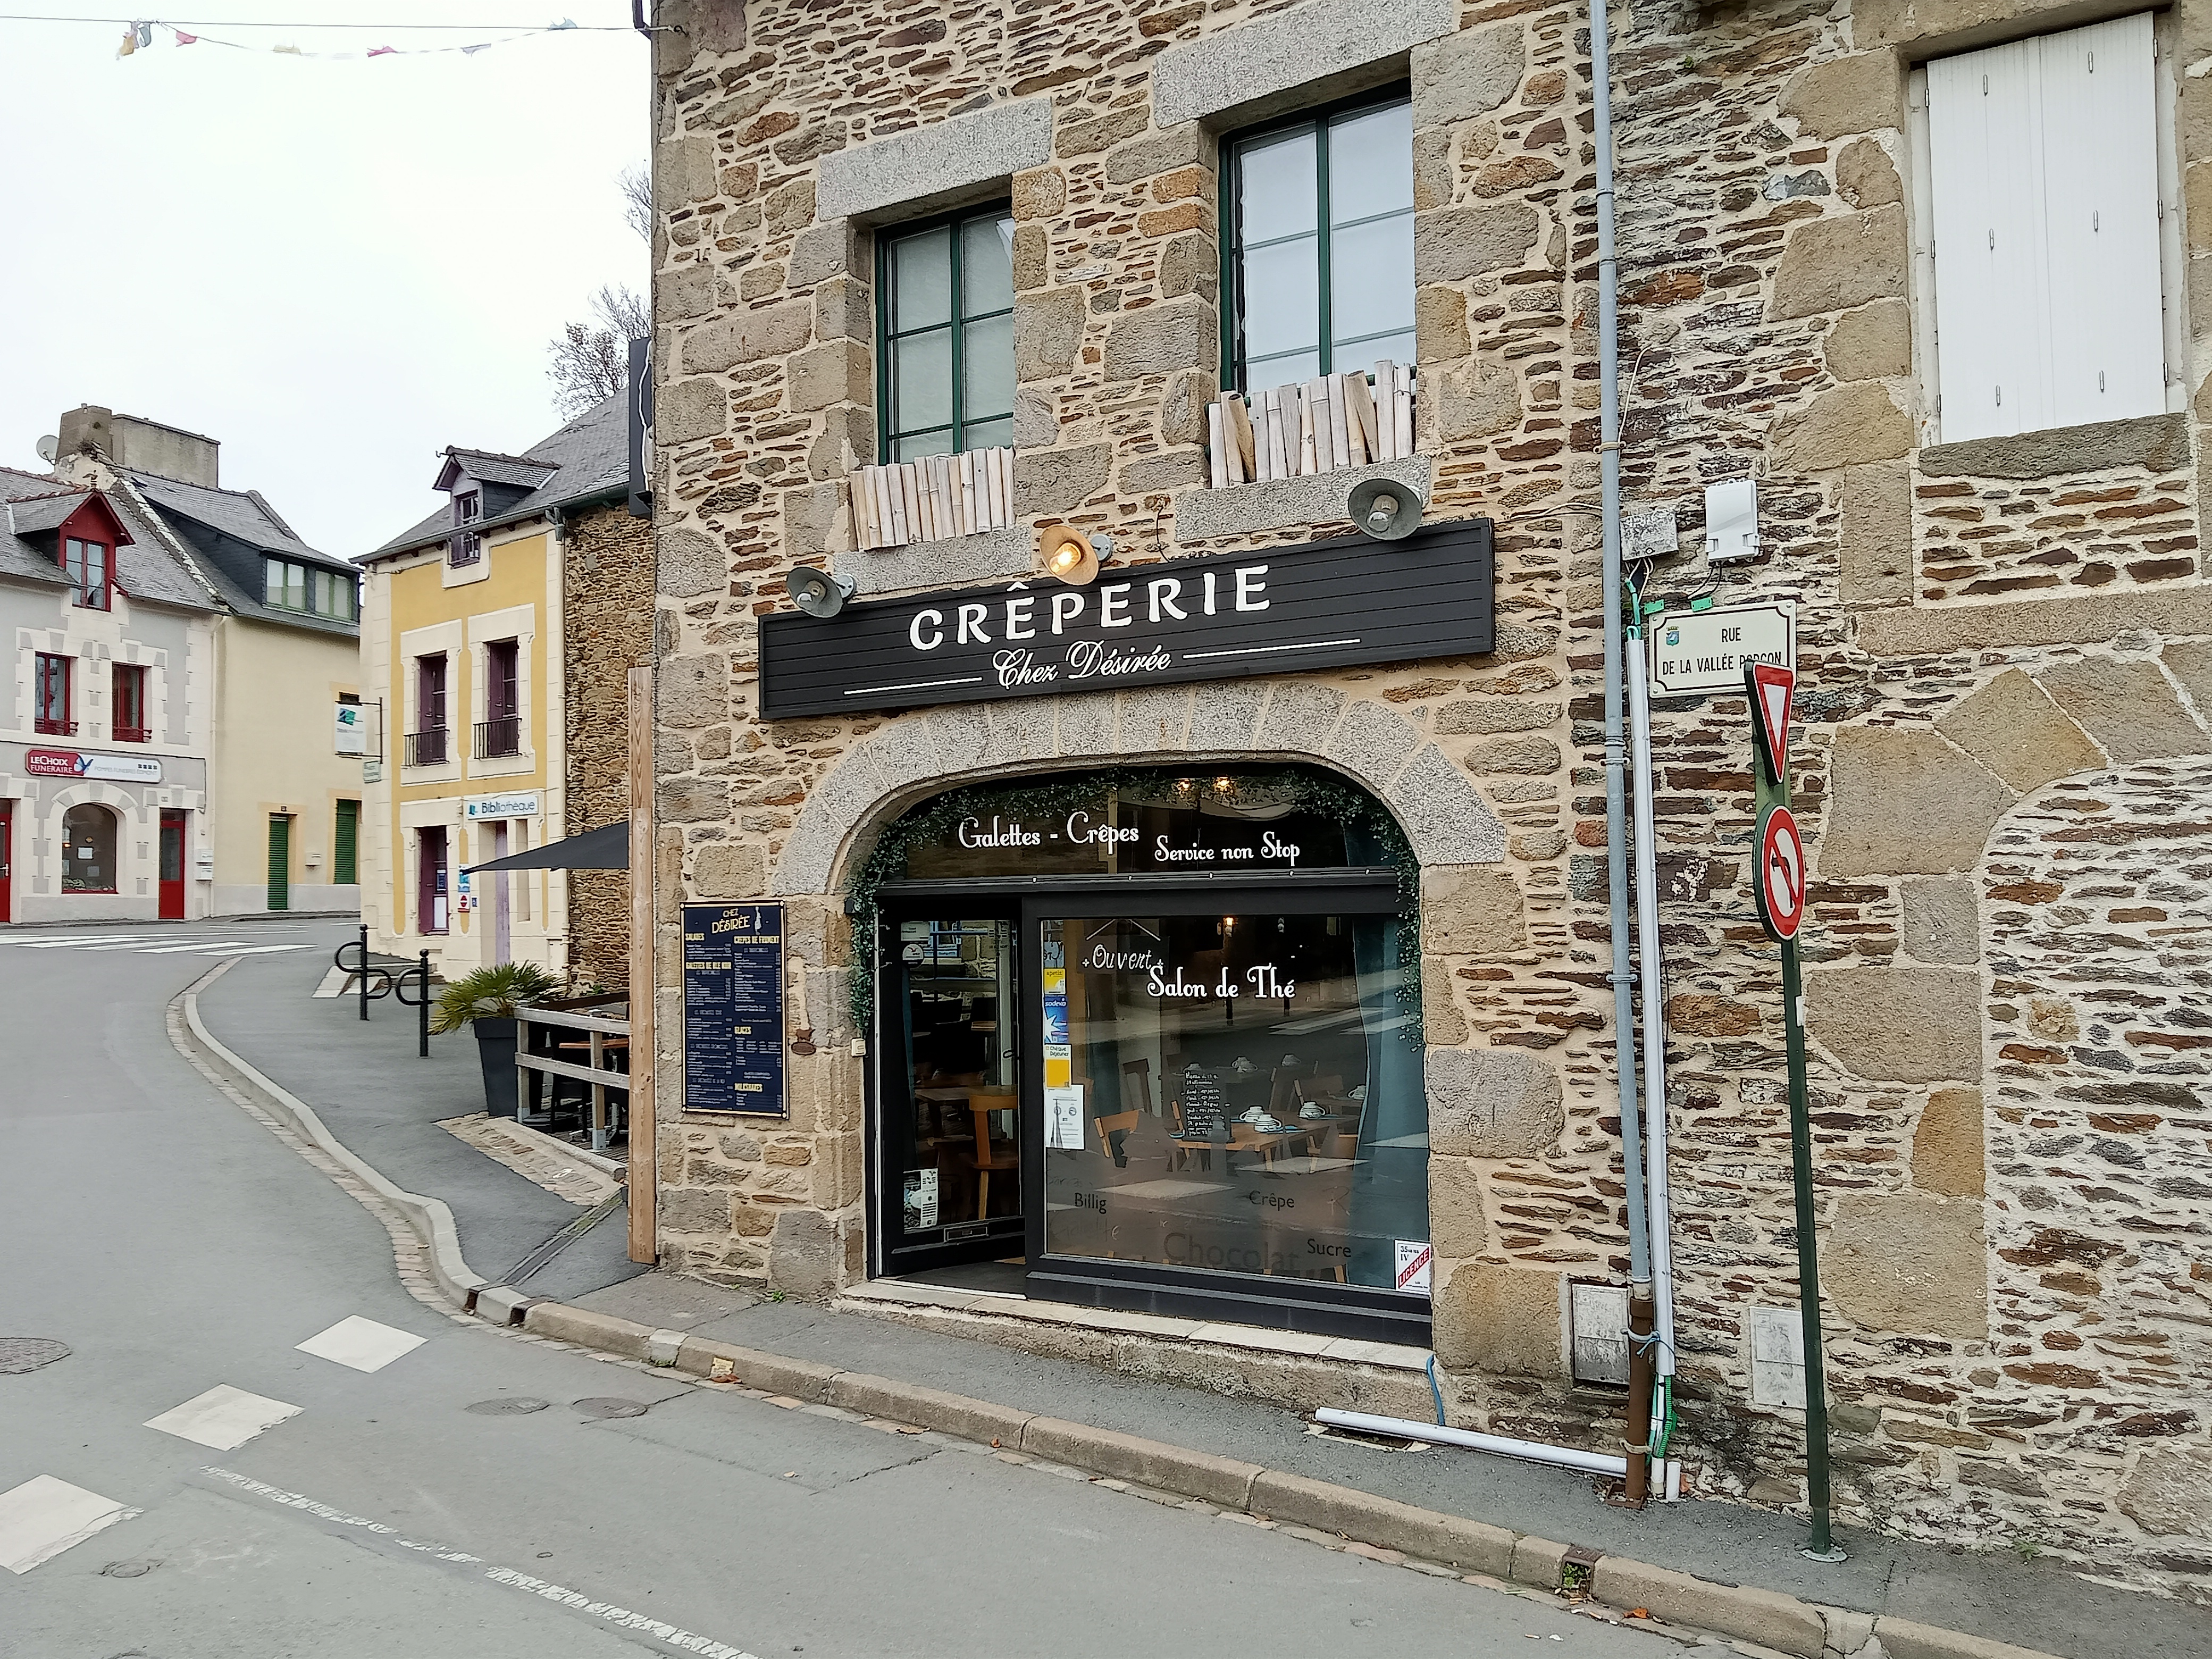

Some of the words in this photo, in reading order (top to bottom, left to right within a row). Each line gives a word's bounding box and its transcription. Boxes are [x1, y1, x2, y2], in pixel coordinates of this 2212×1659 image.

[910, 564, 1270, 650] CRÊPERIE
[1722, 627, 1741, 643] RUE
[992, 648, 1059, 690] Chez
[1066, 640, 1171, 680] Désirée
[1663, 660, 1674, 675] DE
[1680, 659, 1692, 674] LA
[1697, 653, 1734, 673] VALLÉE
[30, 765, 73, 774] FUNERAIRE
[482, 801, 535, 814] Bibliothèque
[958, 815, 1041, 848] Galettes
[1067, 811, 1139, 854] Crêpes
[1154, 834, 1215, 861] Service
[1221, 847, 1254, 859] non
[1261, 832, 1300, 867] Stop
[723, 908, 739, 918] CHEZ
[711, 915, 750, 934] DÉSIRÉE
[1093, 944, 1152, 969] Ouvert
[1147, 965, 1207, 997] Salon
[1216, 966, 1239, 997] de
[1246, 962, 1295, 998] Thé
[1045, 998, 1067, 1007] sodexo
[1074, 1192, 1107, 1214] Billig
[1249, 1189, 1295, 1211] Crêpe
[1307, 1238, 1352, 1258] Sucre
[1399, 1250, 1428, 1286] LICENCE
